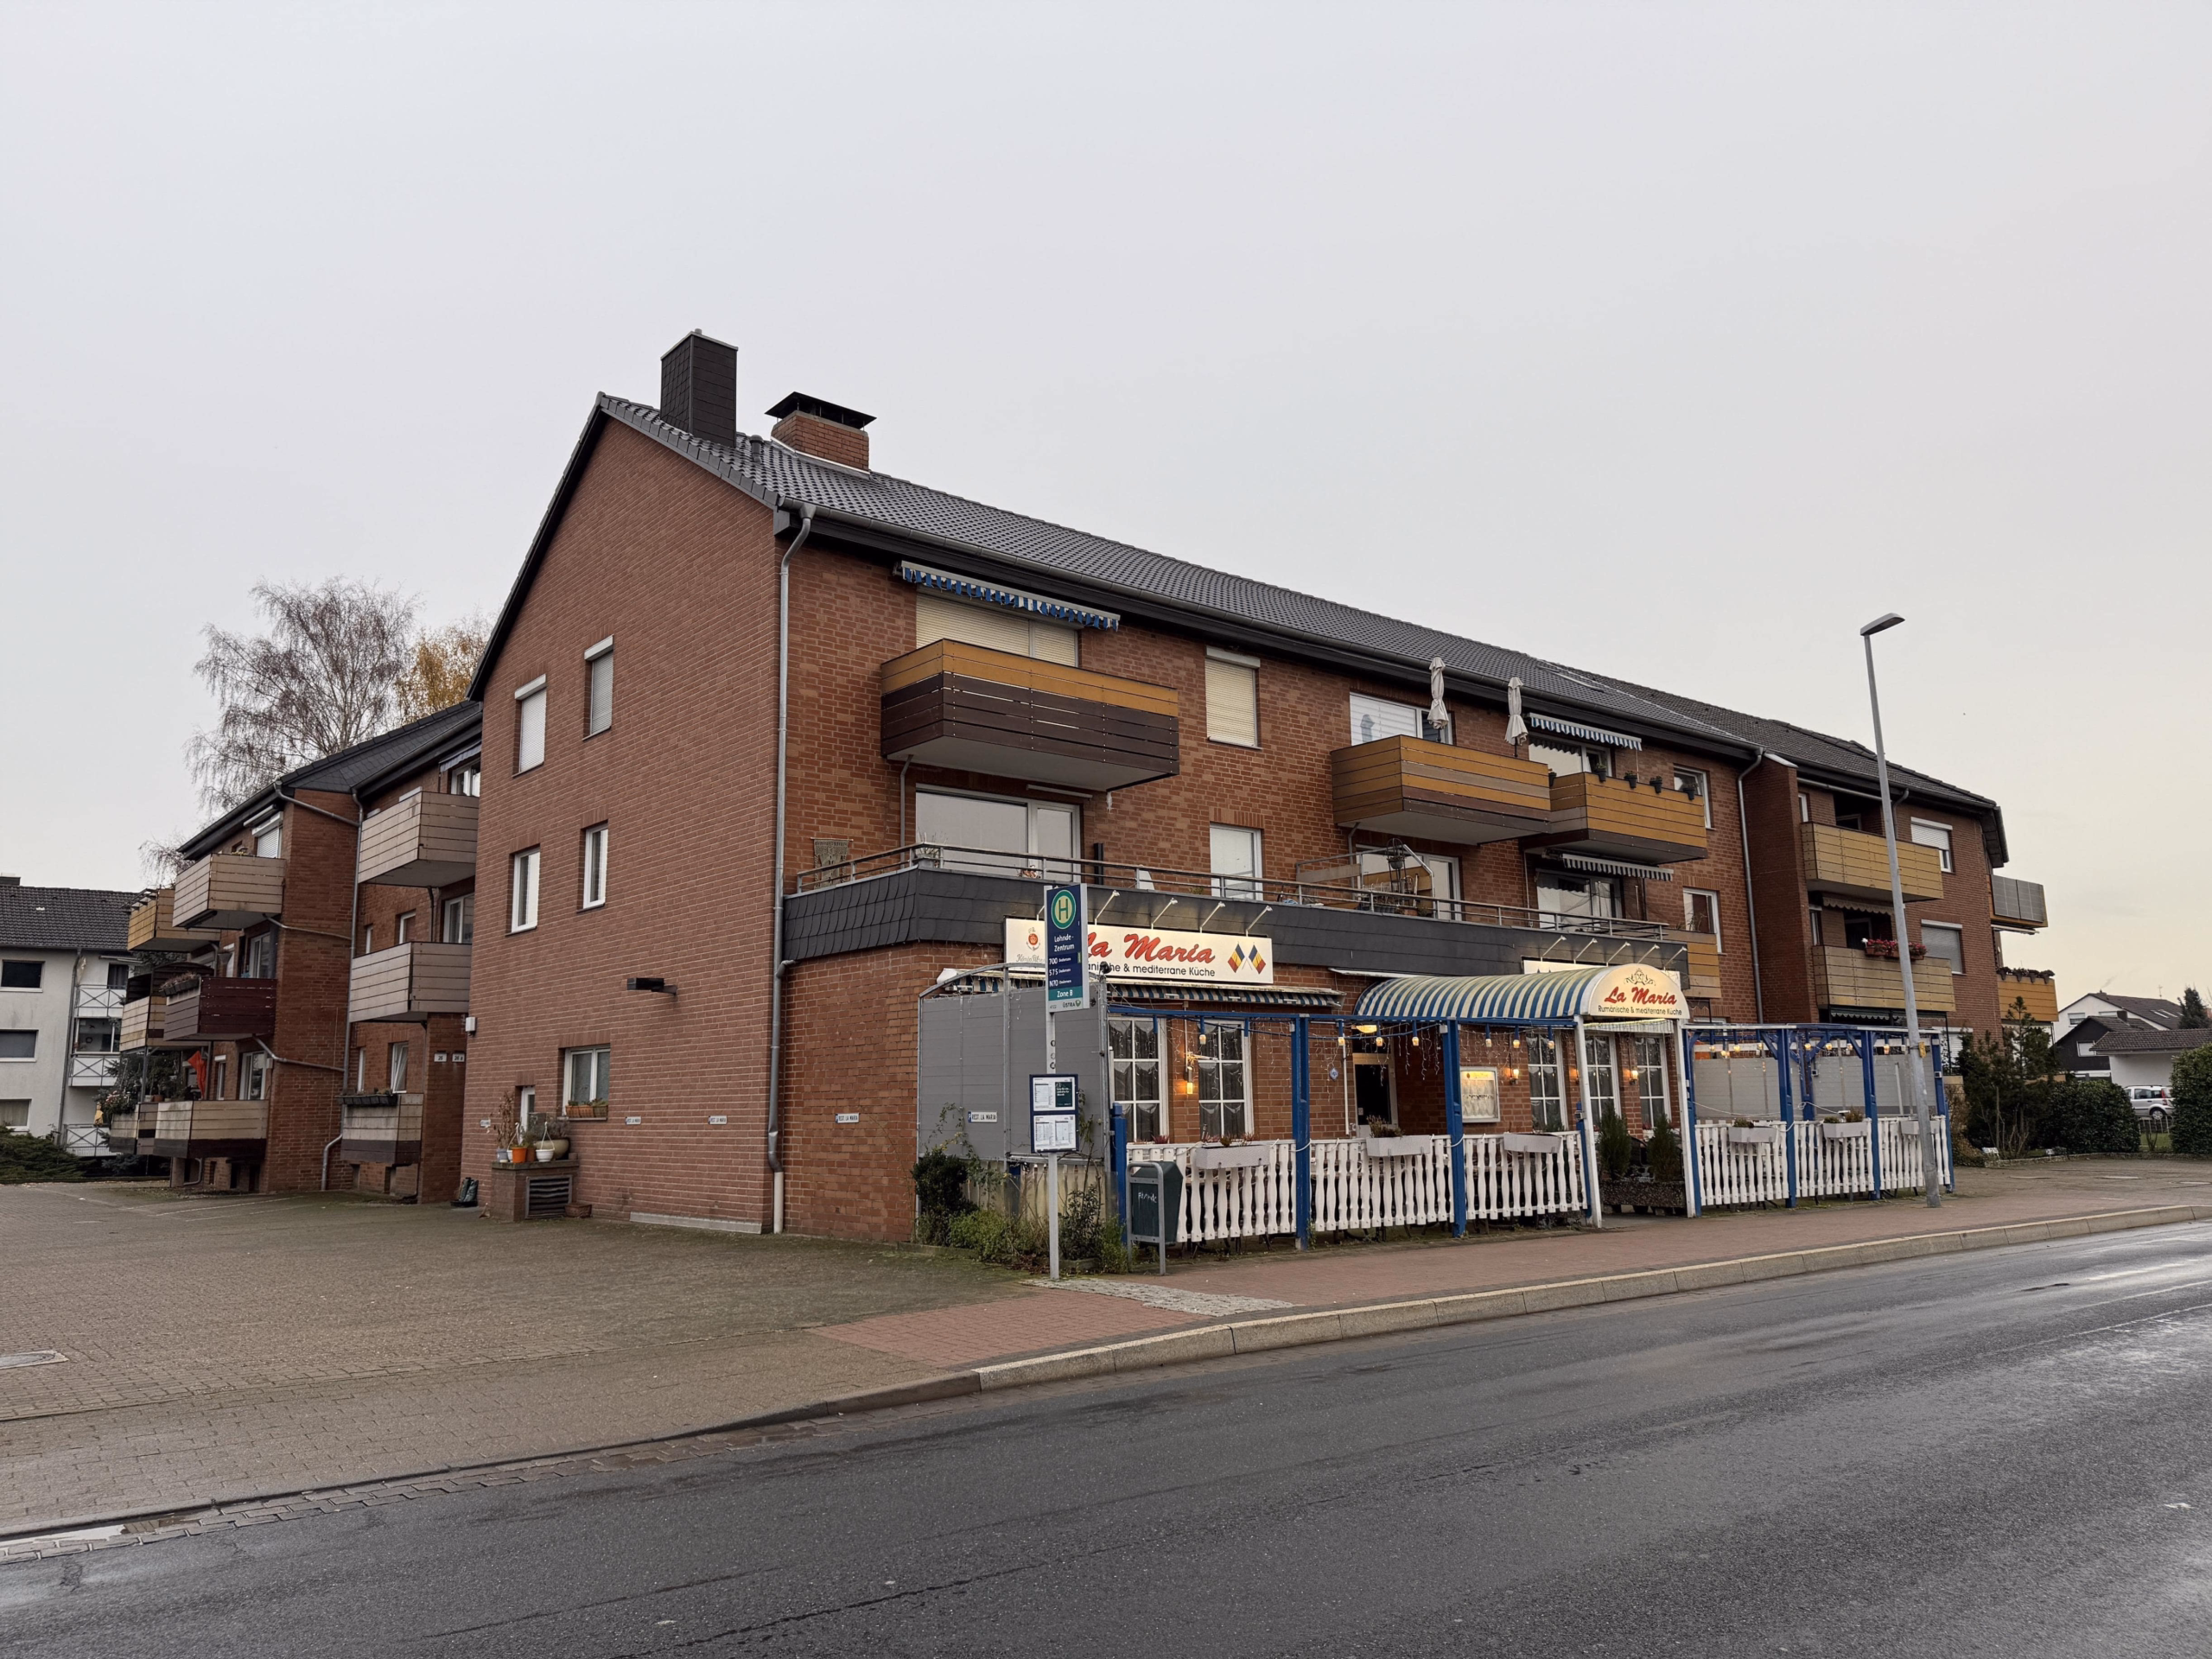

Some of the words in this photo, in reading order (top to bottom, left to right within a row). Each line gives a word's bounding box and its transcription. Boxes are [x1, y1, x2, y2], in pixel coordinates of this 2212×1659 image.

[1058, 899, 1069, 920] H
[1054, 944, 1075, 952] Zentrum
[1123, 933, 1216, 964] Maria
[1123, 963, 1130, 973] &
[1133, 964, 1186, 976] mediterrane
[1189, 966, 1215, 976] Küche
[1049, 979, 1058, 988] N70
[1604, 986, 1626, 1004] La
[1631, 987, 1677, 1005] Maria
[1599, 1005, 1630, 1014] Rumänische
[1636, 1007, 1666, 1015] mediterrane
[1667, 1007, 1682, 1016] Küche
